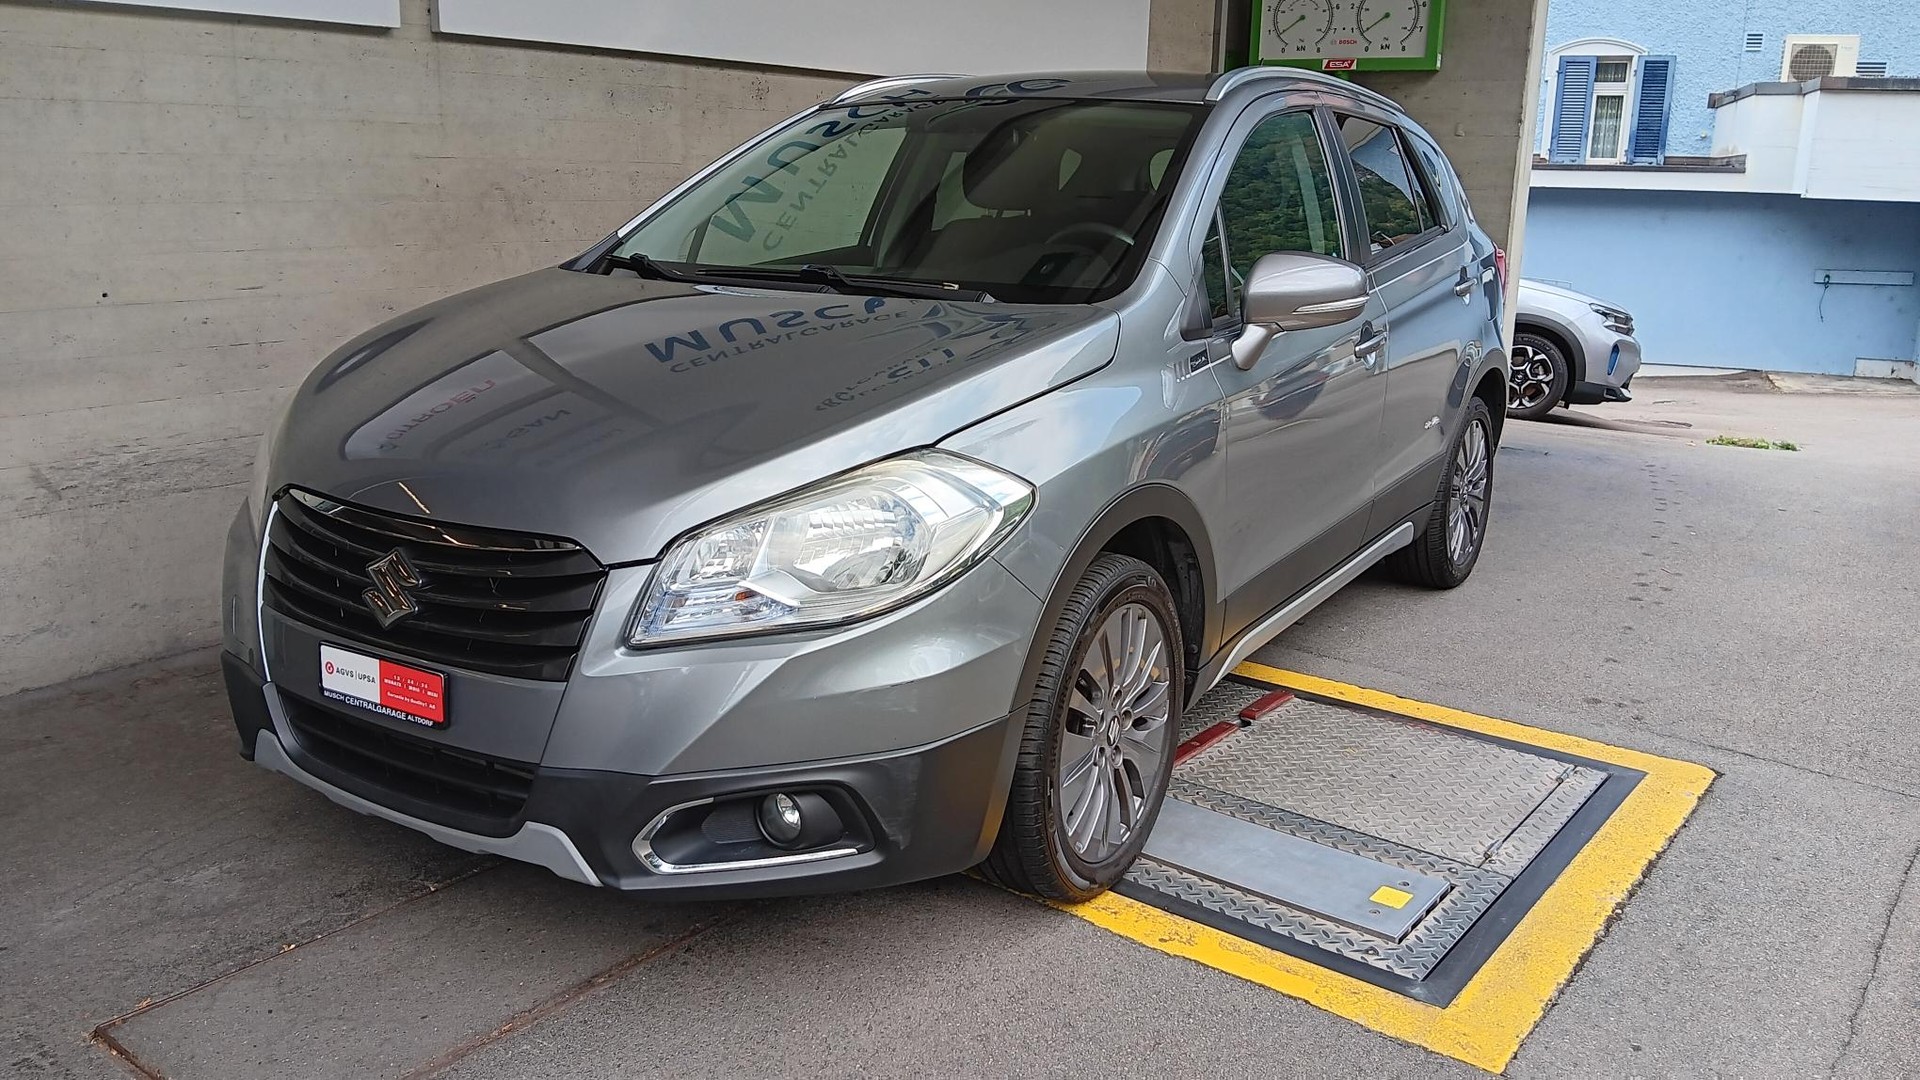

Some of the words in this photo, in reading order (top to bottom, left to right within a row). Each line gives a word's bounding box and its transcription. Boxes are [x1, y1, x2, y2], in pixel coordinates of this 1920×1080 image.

[336, 667, 354, 678] AGVS
[358, 673, 376, 683] UPSA
[324, 690, 344, 701] MUSCH
[345, 697, 406, 720] CENTRALGARAGE
[407, 714, 434, 727] ALTDORF
